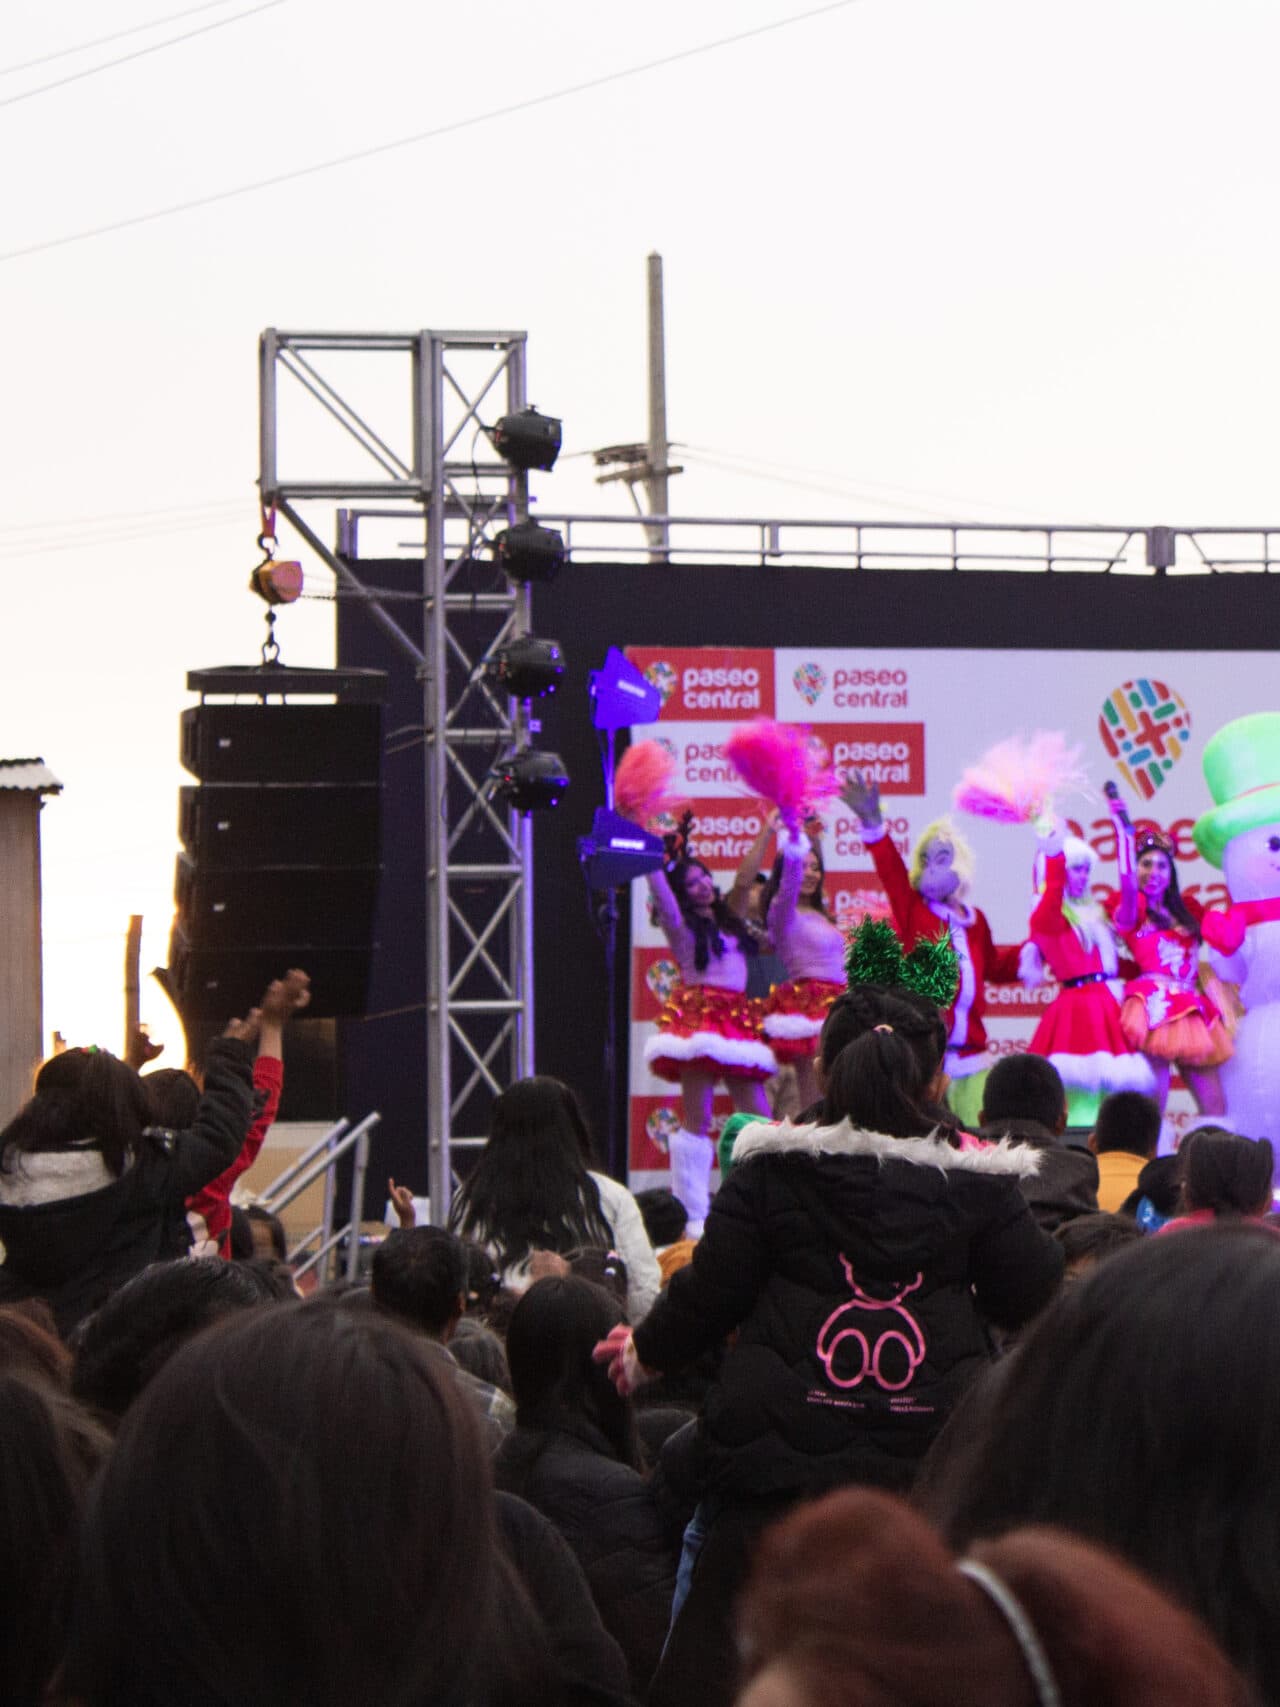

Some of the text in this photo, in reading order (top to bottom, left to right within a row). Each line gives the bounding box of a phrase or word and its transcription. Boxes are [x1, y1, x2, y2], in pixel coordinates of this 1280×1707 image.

[683, 668, 760, 692] paseo
[833, 669, 907, 690] paseo
[683, 688, 760, 709] central
[833, 689, 908, 708] central
[834, 741, 909, 764] paseo
[686, 836, 754, 857] centra
